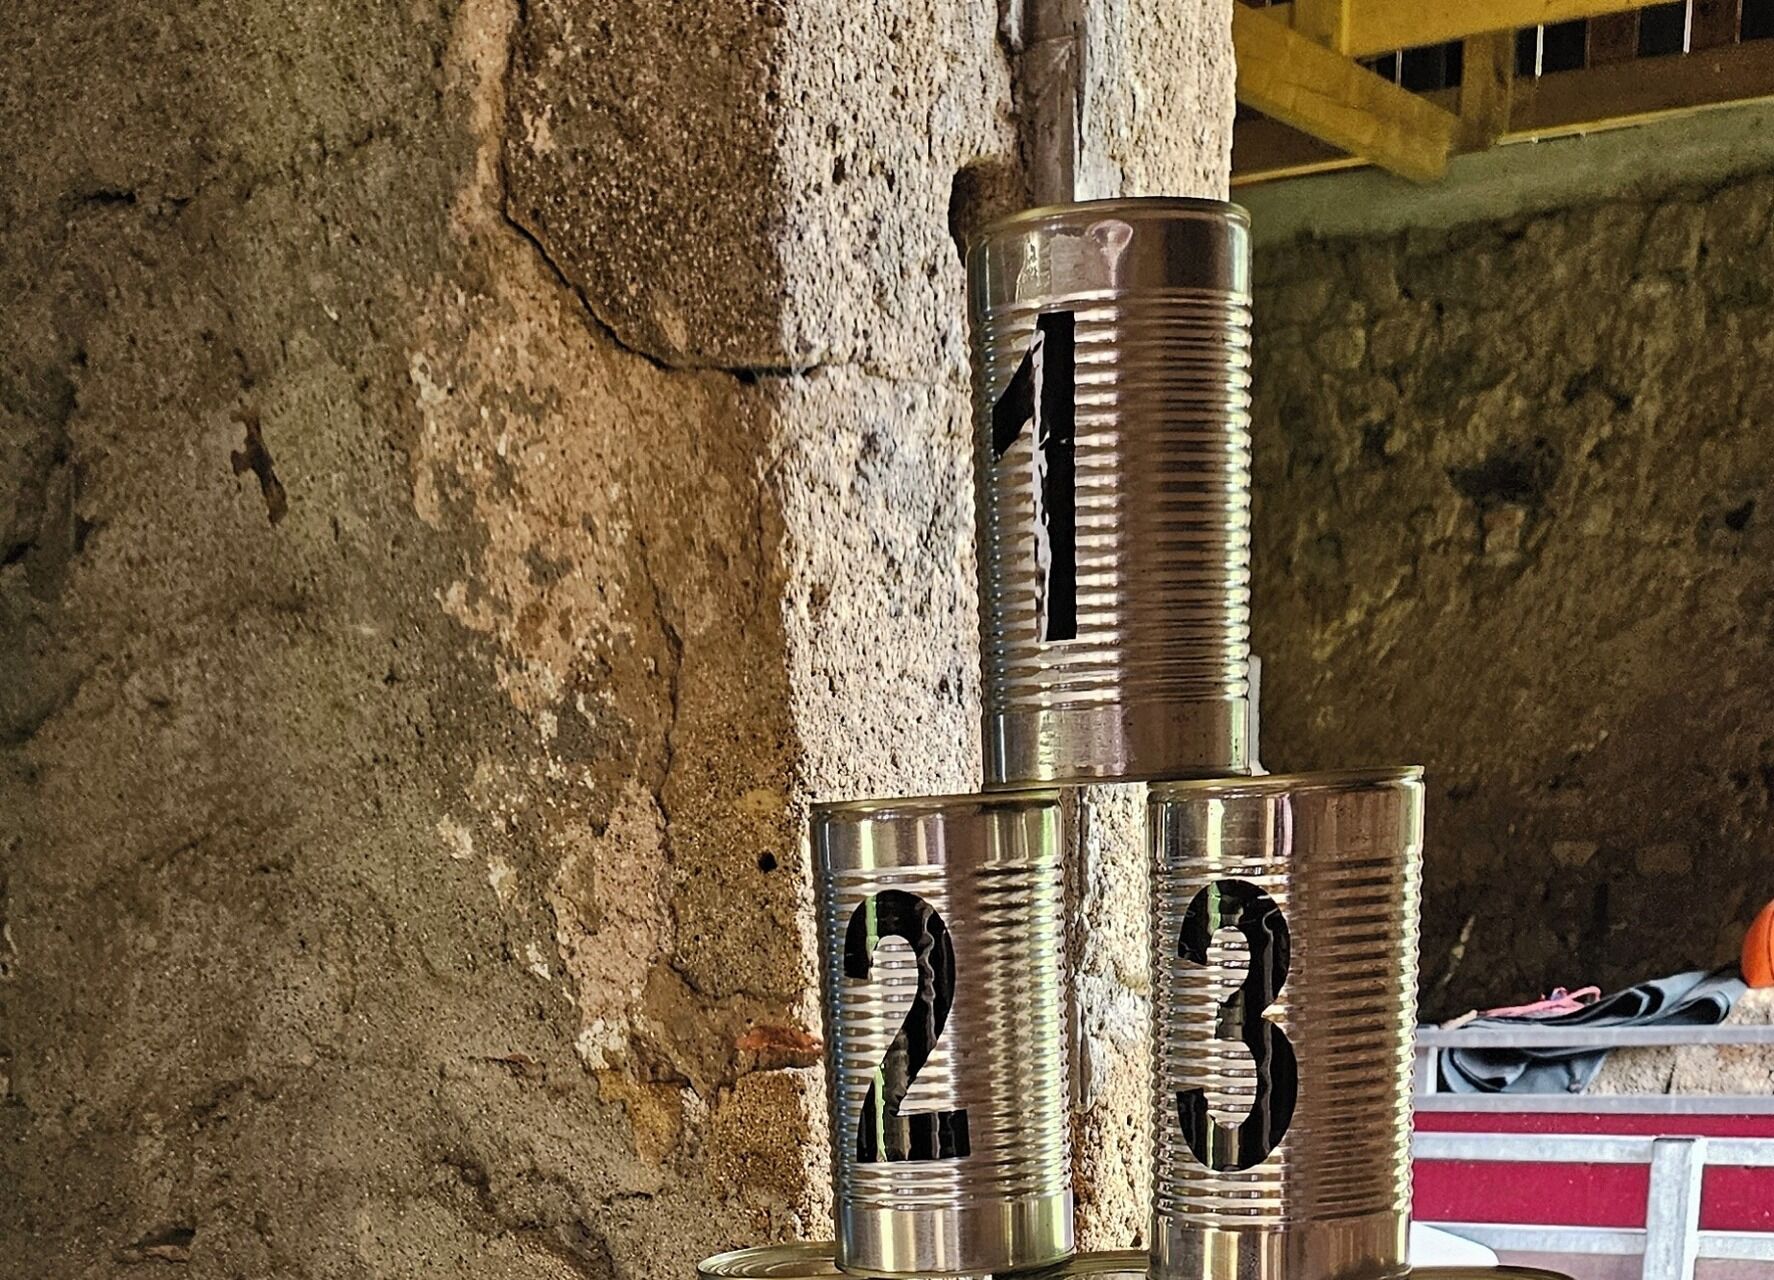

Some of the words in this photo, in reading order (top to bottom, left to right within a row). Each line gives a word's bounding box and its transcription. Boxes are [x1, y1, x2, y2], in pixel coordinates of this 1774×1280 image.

[992, 311, 1077, 641] 1
[844, 890, 970, 1161] 2
[1175, 879, 1297, 1170] 3
